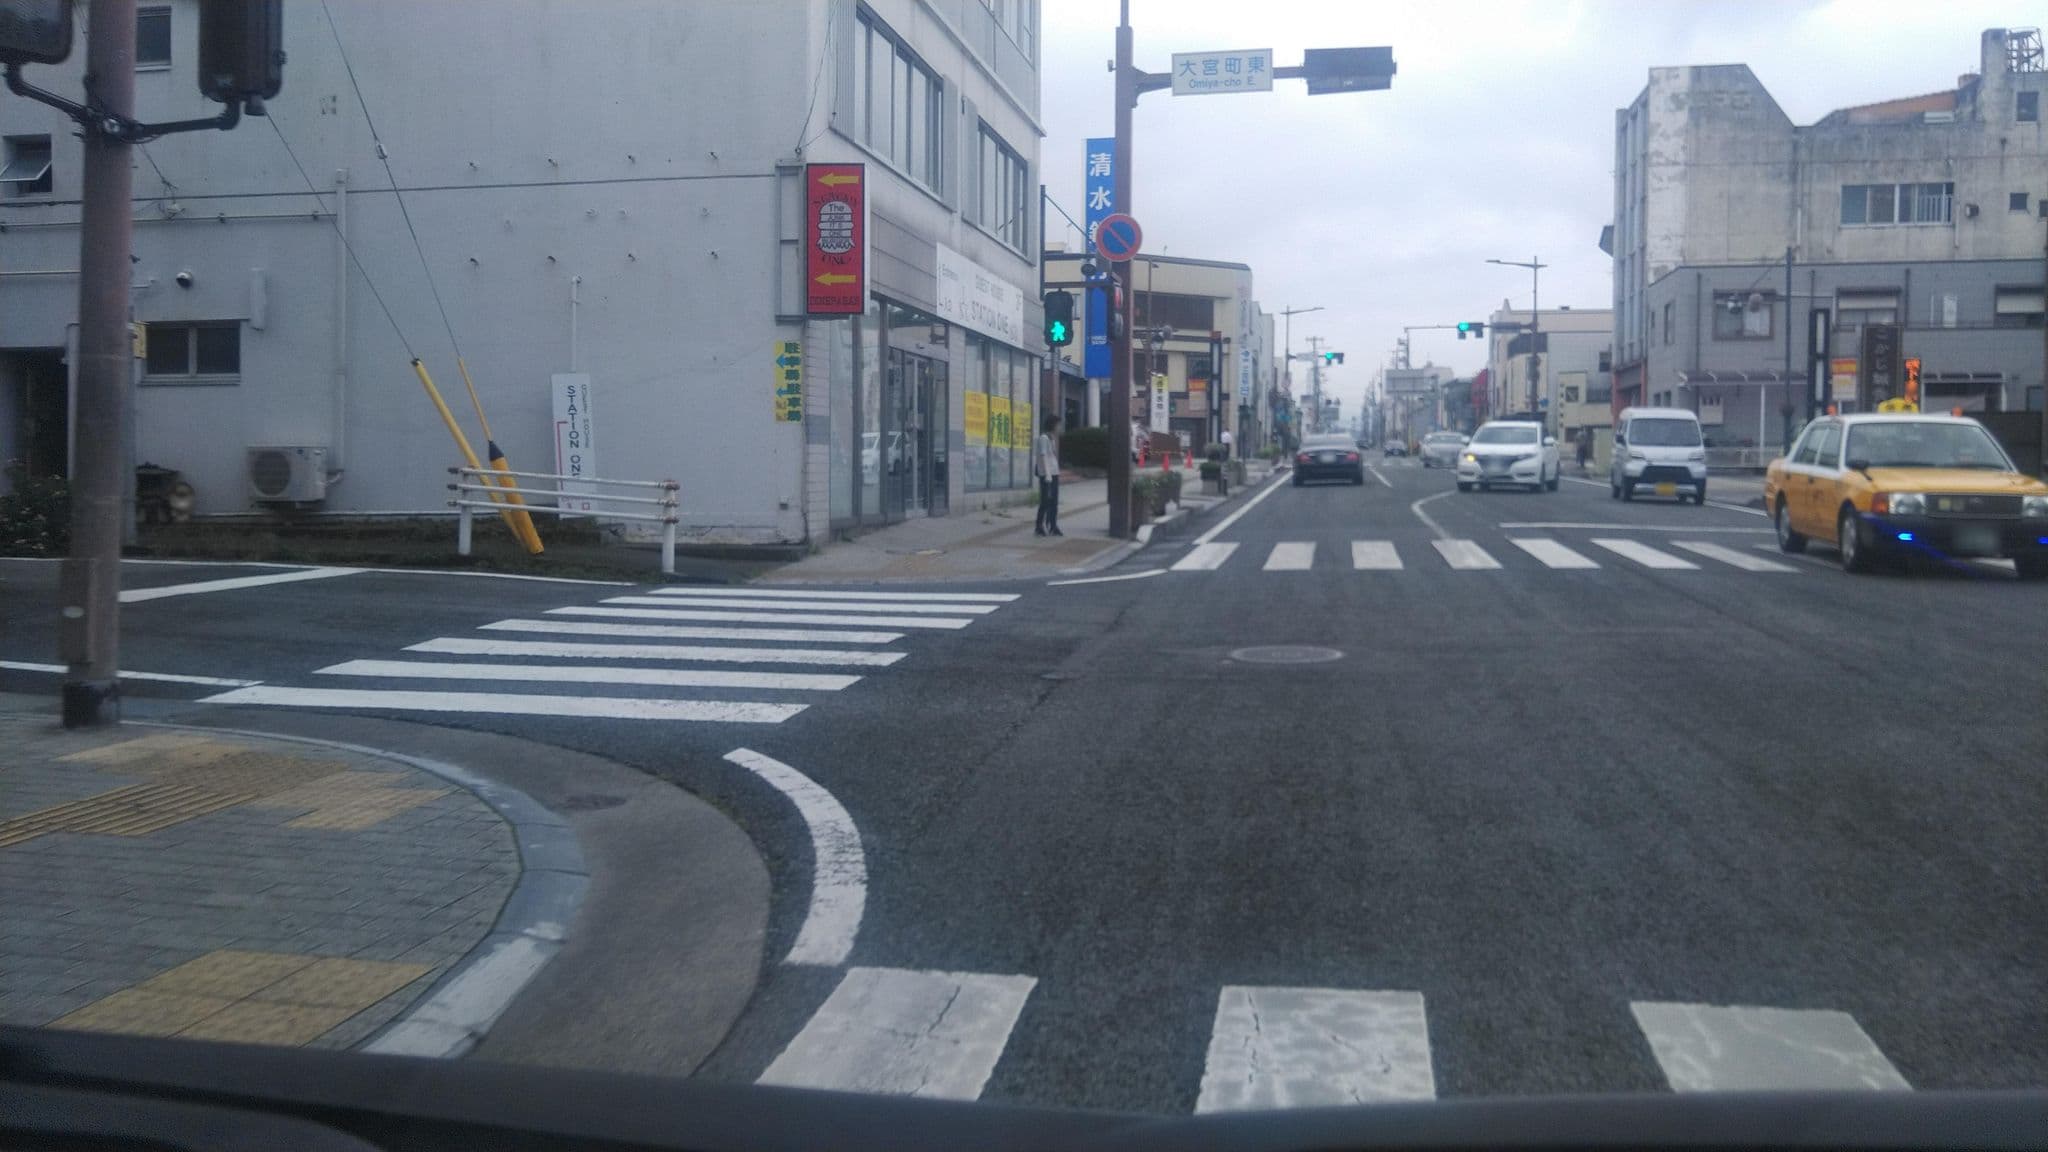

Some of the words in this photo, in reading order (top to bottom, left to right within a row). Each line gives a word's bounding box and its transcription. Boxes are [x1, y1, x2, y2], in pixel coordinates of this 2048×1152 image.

[1179, 56, 1265, 77] 大宮町東
[567, 385, 579, 448] STATION
